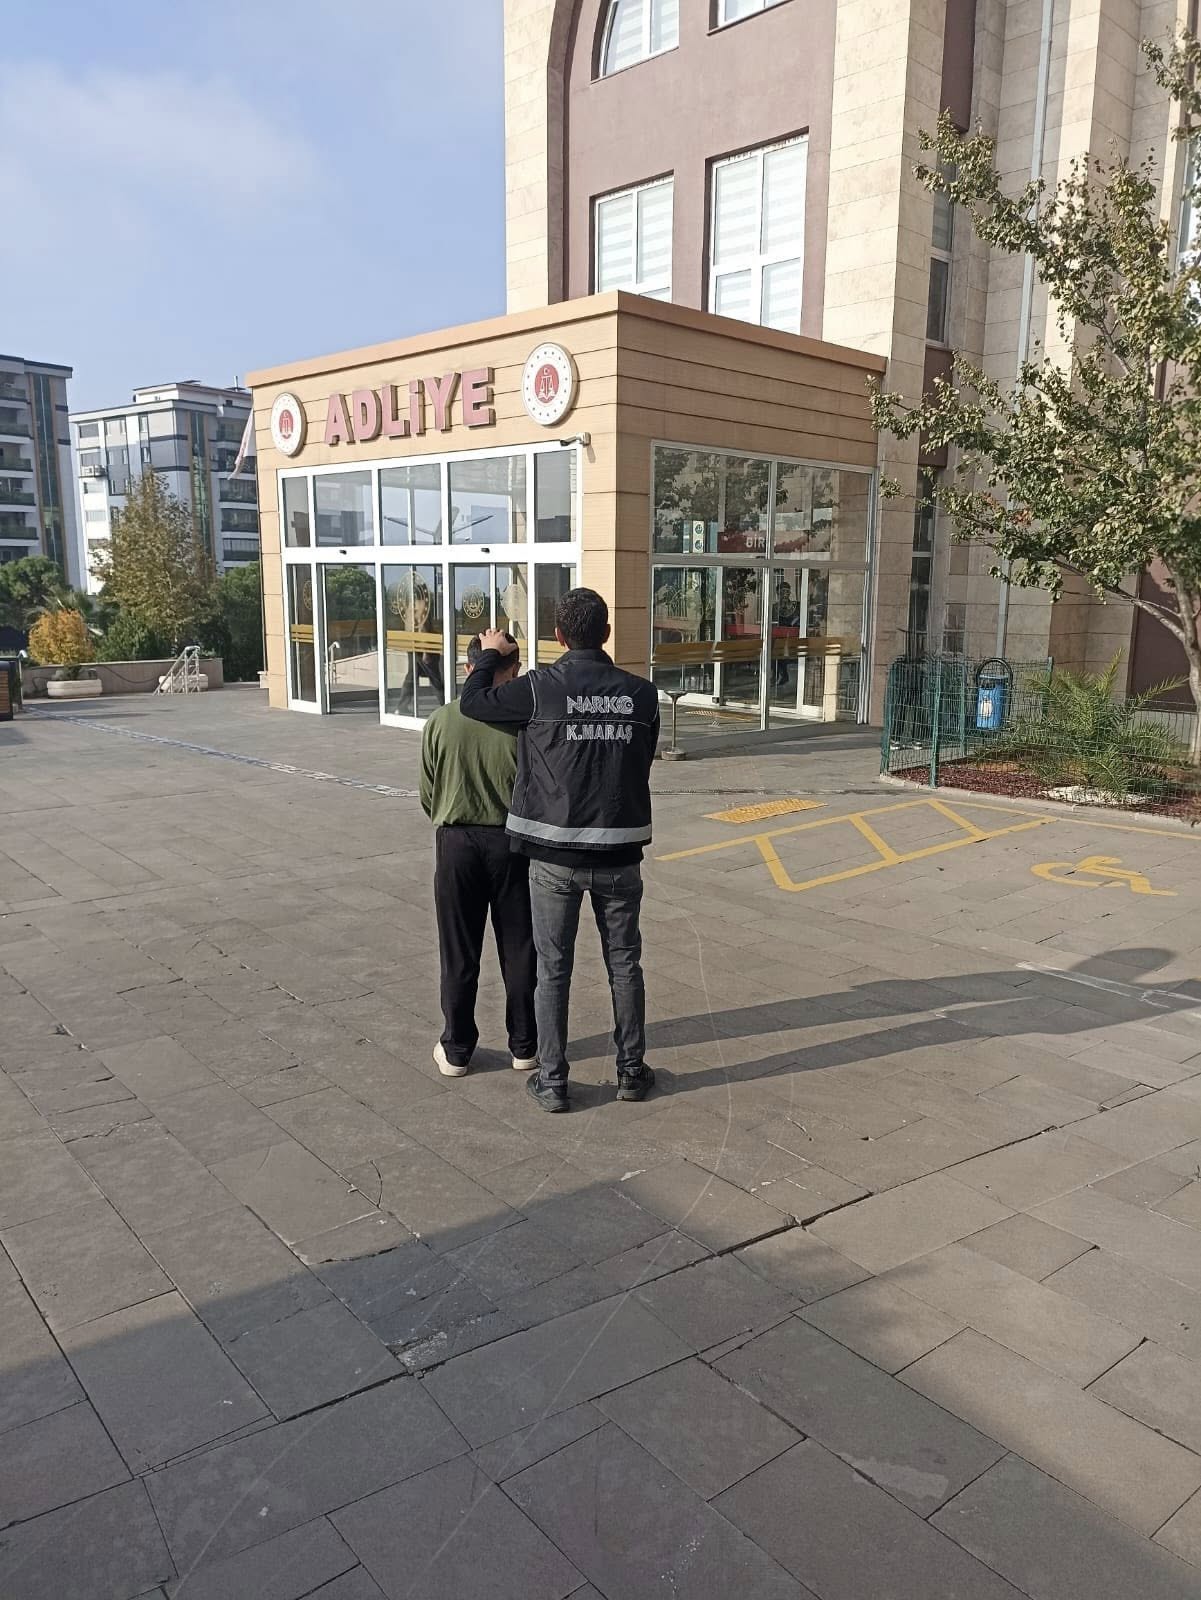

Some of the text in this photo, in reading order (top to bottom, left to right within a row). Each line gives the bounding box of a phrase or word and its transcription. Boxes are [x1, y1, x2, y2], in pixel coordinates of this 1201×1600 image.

[324, 366, 496, 447] ADLİYE
[566, 695, 634, 715] NARKO
[566, 724, 633, 744] K.MARAŞ
